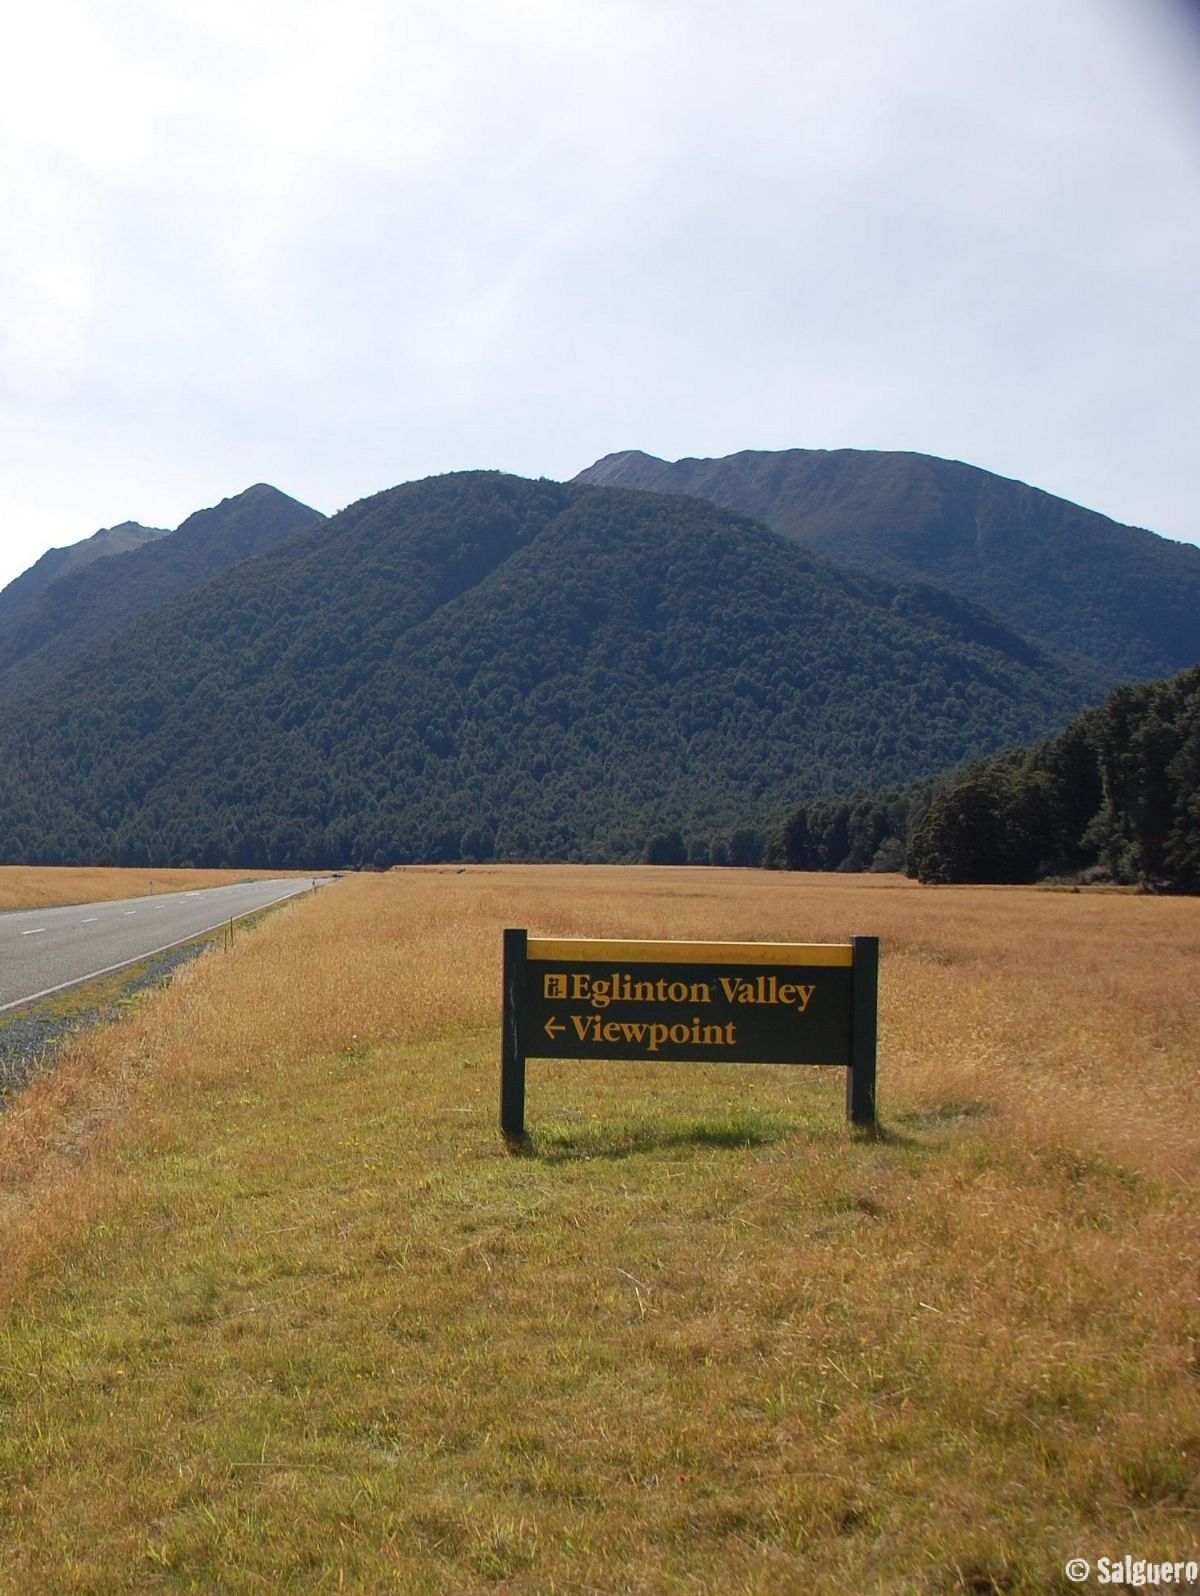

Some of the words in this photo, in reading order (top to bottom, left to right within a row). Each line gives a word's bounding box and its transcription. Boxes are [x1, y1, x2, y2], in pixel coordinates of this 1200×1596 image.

[570, 973, 711, 1008] Eglinton
[719, 976, 816, 1012] Valley
[570, 1015, 737, 1051] Viewpoint
